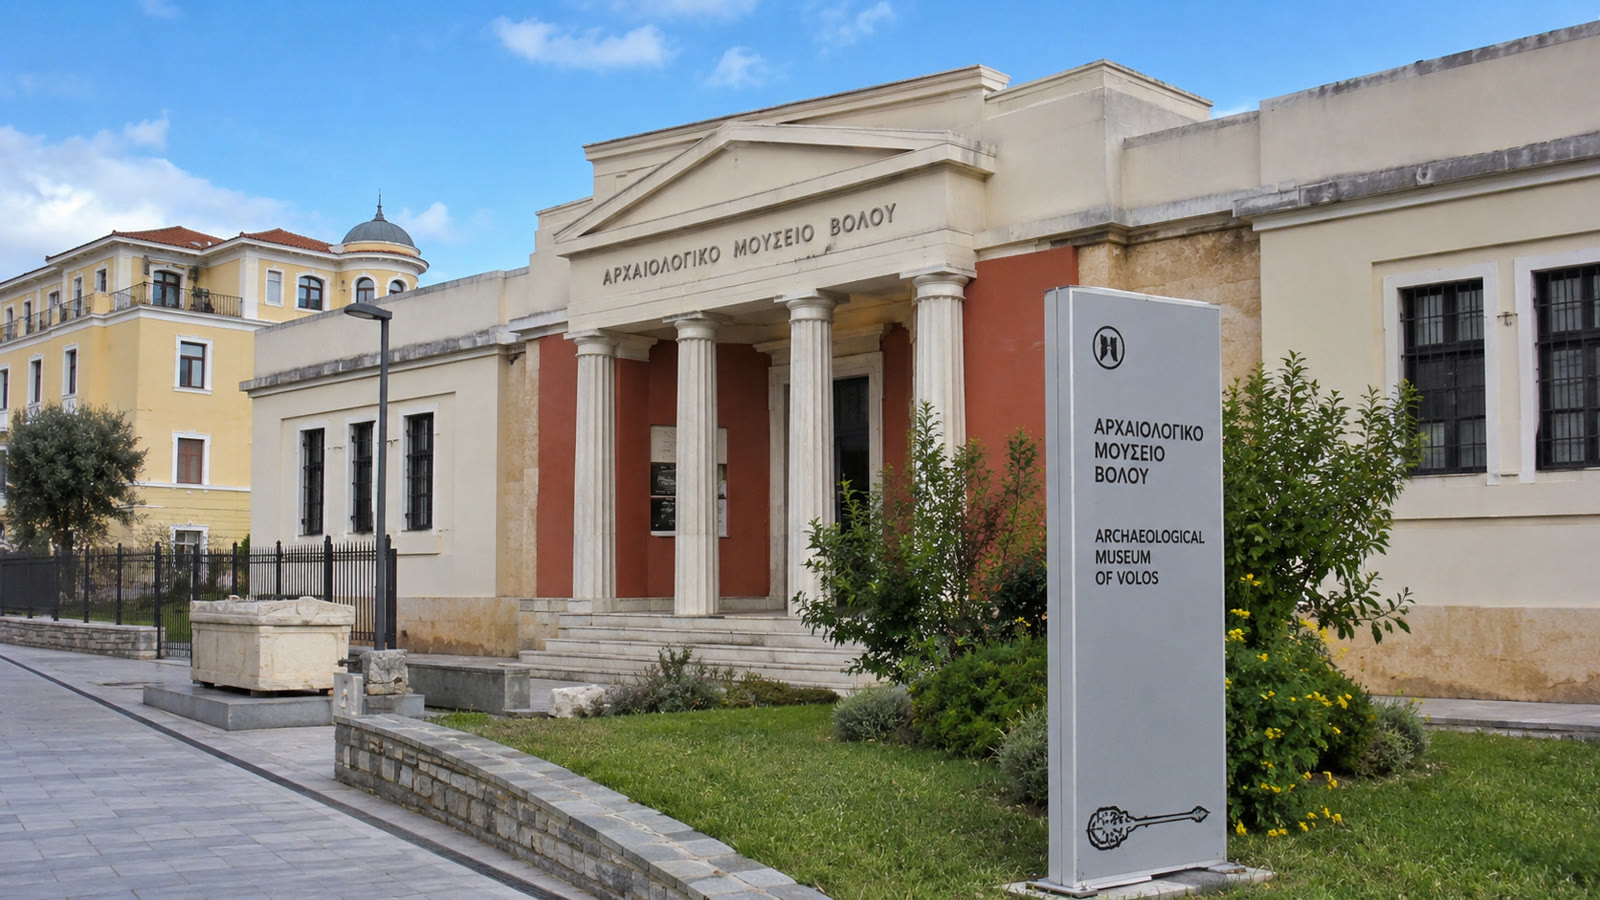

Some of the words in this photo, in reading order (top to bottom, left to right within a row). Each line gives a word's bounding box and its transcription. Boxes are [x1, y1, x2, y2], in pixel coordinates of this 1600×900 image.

[603, 245, 721, 285] ΑΡΧΑΙΟΛΟΓΙΚΟ
[733, 224, 815, 258] ΜΟΥΣΕΙΟ
[830, 202, 897, 236] ΒΟΛΟΥ
[1094, 418, 1204, 442] ΑΡΧΑΙΟΛΟΓΙΚΟ
[1094, 442, 1165, 462] ΜΟΥΣΕΙΟ
[1095, 466, 1149, 485] ΒΟΛΟΥ
[1095, 528, 1205, 544] ARCHAEOLOGICAL
[1095, 550, 1151, 565] MUSEUM
[1095, 571, 1113, 586] OF
[1117, 571, 1159, 585] VOLOS
